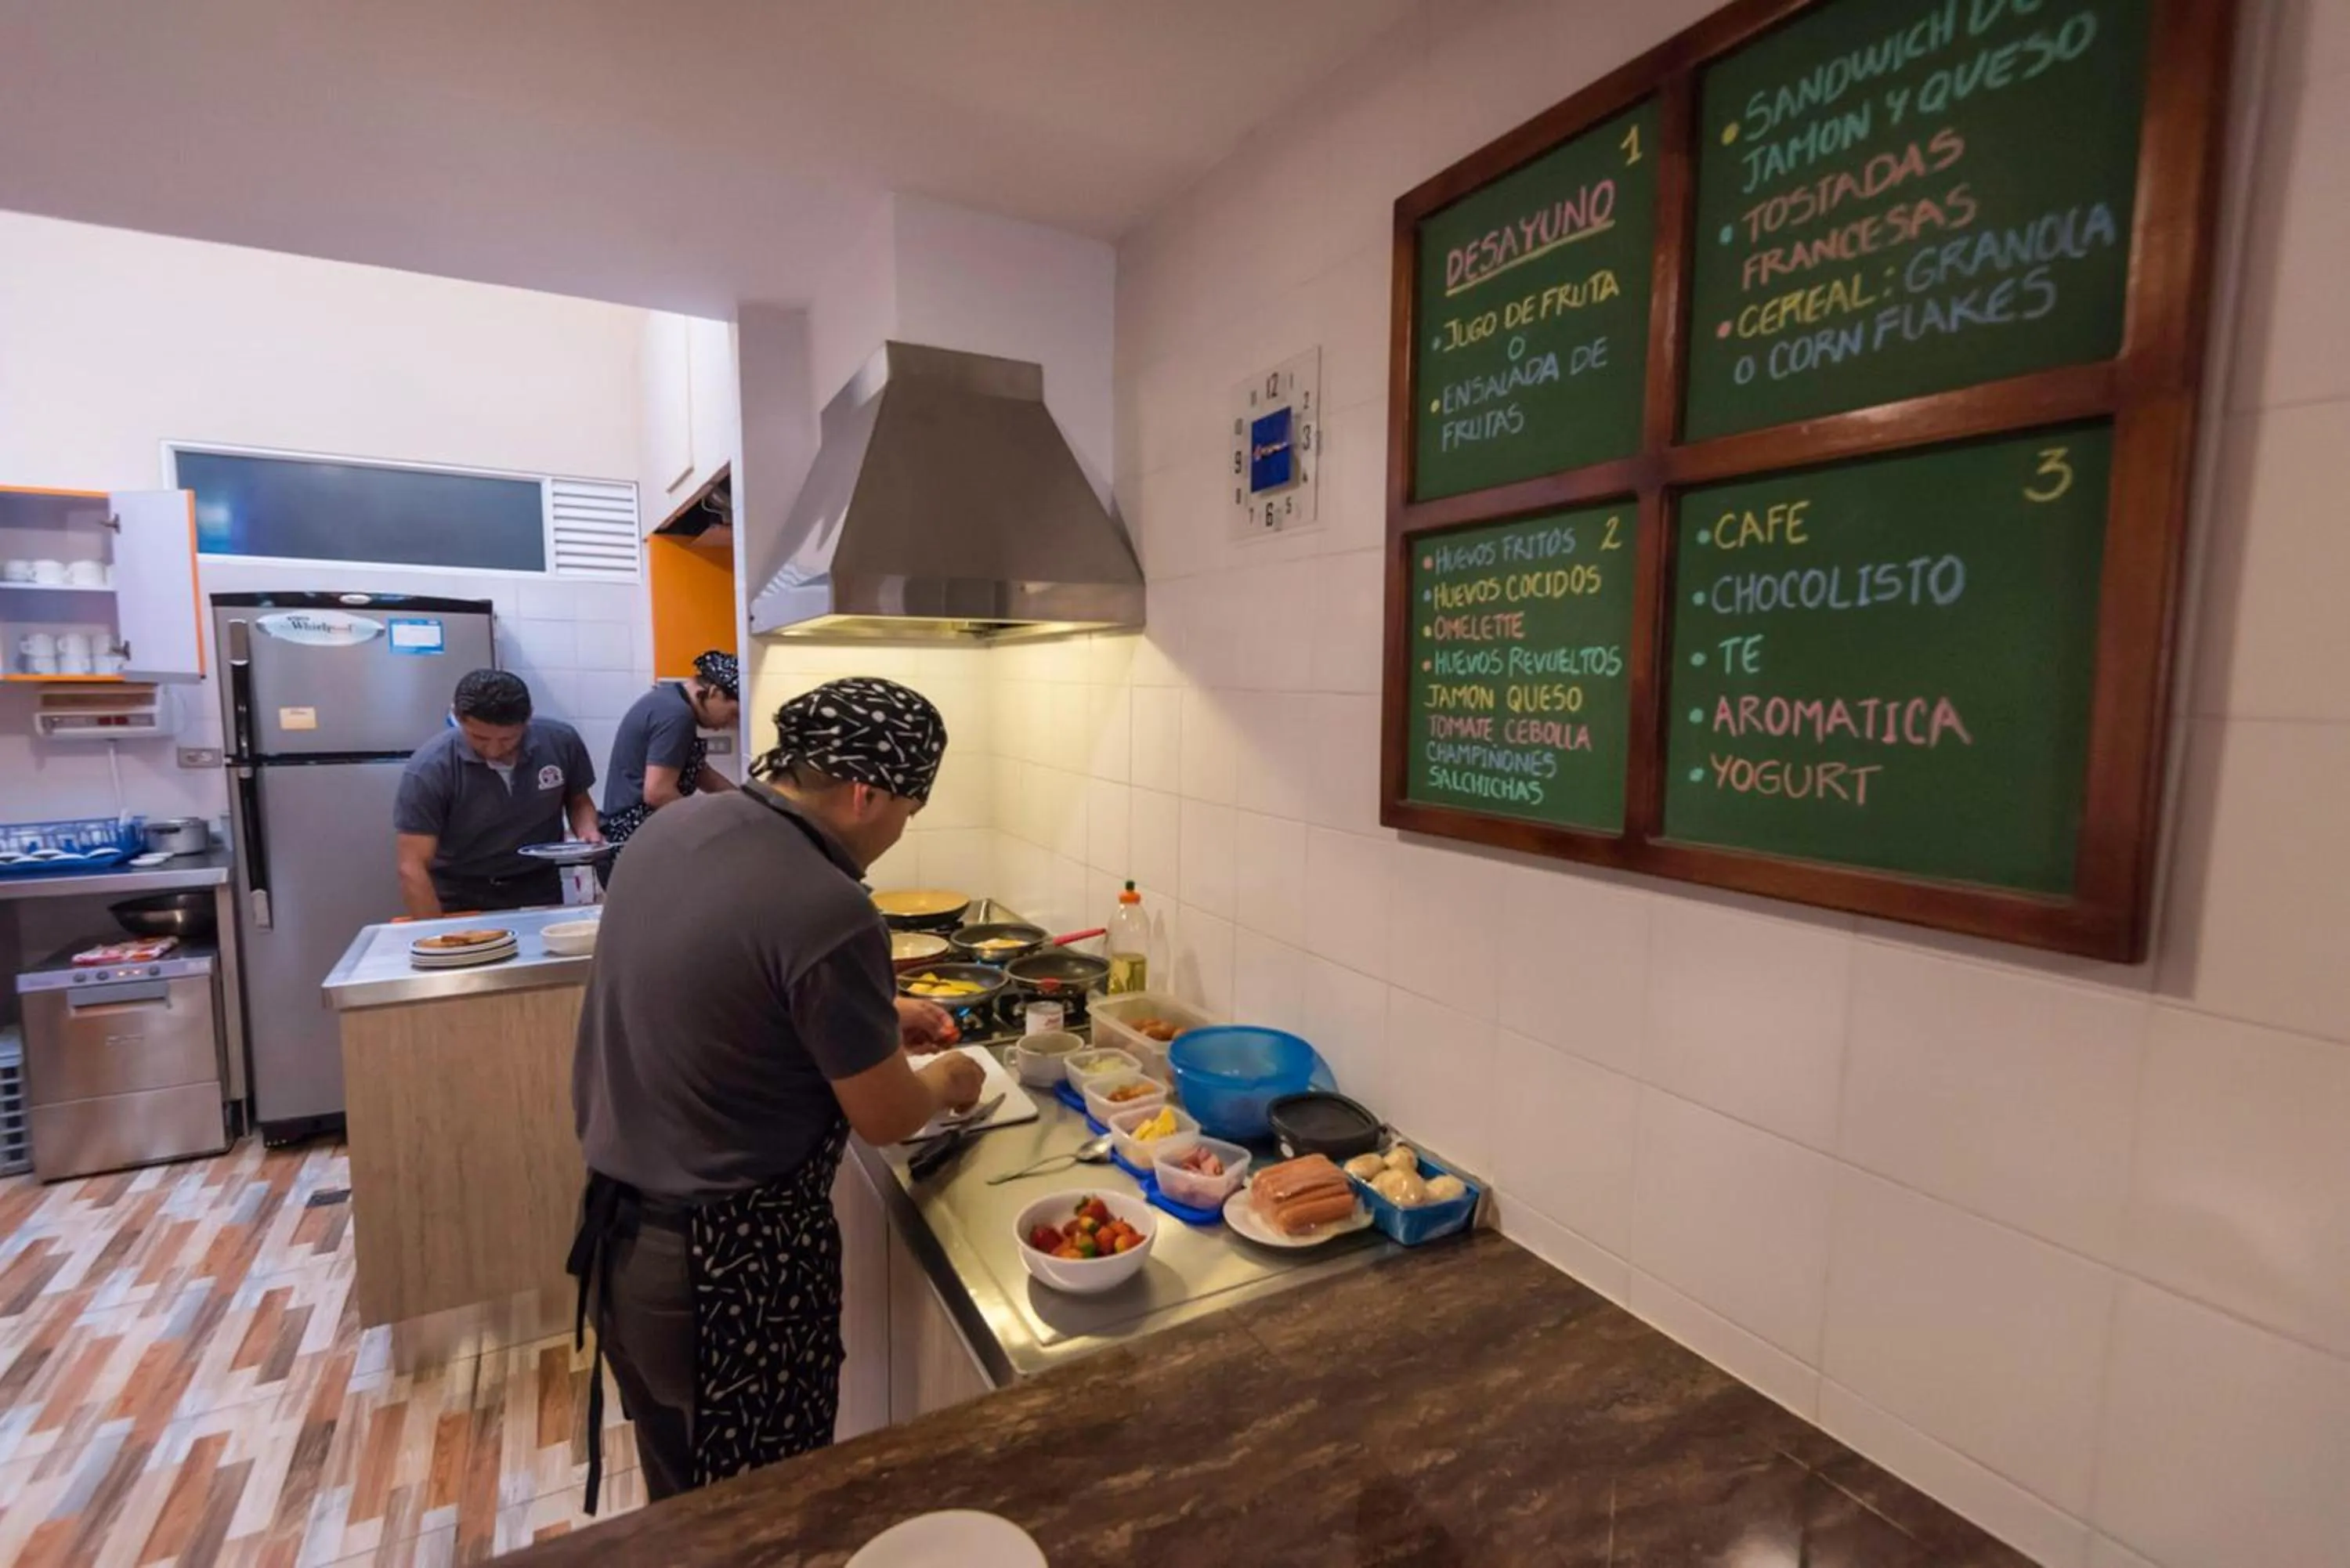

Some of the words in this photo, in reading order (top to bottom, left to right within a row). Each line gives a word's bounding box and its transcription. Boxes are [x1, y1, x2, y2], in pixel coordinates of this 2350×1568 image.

[1744, 0, 1958, 141] SANDWICH
[1967, 0, 2042, 35] D
[1741, 105, 1871, 193] JAMON
[1885, 88, 1909, 125] Y
[1917, 10, 2097, 114] QUESO
[1619, 123, 1643, 166] 1
[1741, 128, 1965, 243] TOSTADAS
[1446, 179, 1615, 288] DESAYUNO
[1741, 183, 1978, 291] FRANCESAS
[1904, 202, 2115, 294] GRANOLA
[1443, 315, 1497, 352] JUGO
[1505, 294, 1536, 329] DE
[1539, 269, 1620, 320] FRUTA
[1733, 354, 1755, 385] O
[1768, 322, 1864, 381] CORN
[1873, 266, 2057, 350] FLAKES
[1507, 335, 1526, 360] O
[1266, 371, 1279, 400] 12
[1442, 351, 1560, 415] ENSALADA
[1570, 336, 1609, 376] DE
[1442, 403, 1525, 453] FRUTAS
[2023, 446, 2074, 503] 3
[1599, 515, 1623, 551] 2
[1714, 500, 1810, 550] CAFE
[1435, 540, 1497, 575] HUEVOS
[1501, 526, 1578, 562] FRITOS
[1433, 580, 1502, 610] HUEVOS
[1505, 564, 1603, 603] COCIDOS
[1711, 553, 1966, 615] CHOCOLISTO
[1434, 611, 1526, 641] OMELETTE
[1434, 647, 1504, 676] HUEVOS
[1508, 645, 1623, 677] REVUELTOS
[1719, 634, 1764, 674] TE
[1423, 683, 1495, 709] JAMON
[1506, 685, 1584, 713] QUESO
[1712, 695, 1973, 748] AROMATICA
[1428, 714, 1495, 741] TOMATE
[1504, 718, 1593, 752] CEBOLLA
[1427, 765, 1545, 806] SALCHICHAS
[1710, 753, 1884, 807] YOGURT
